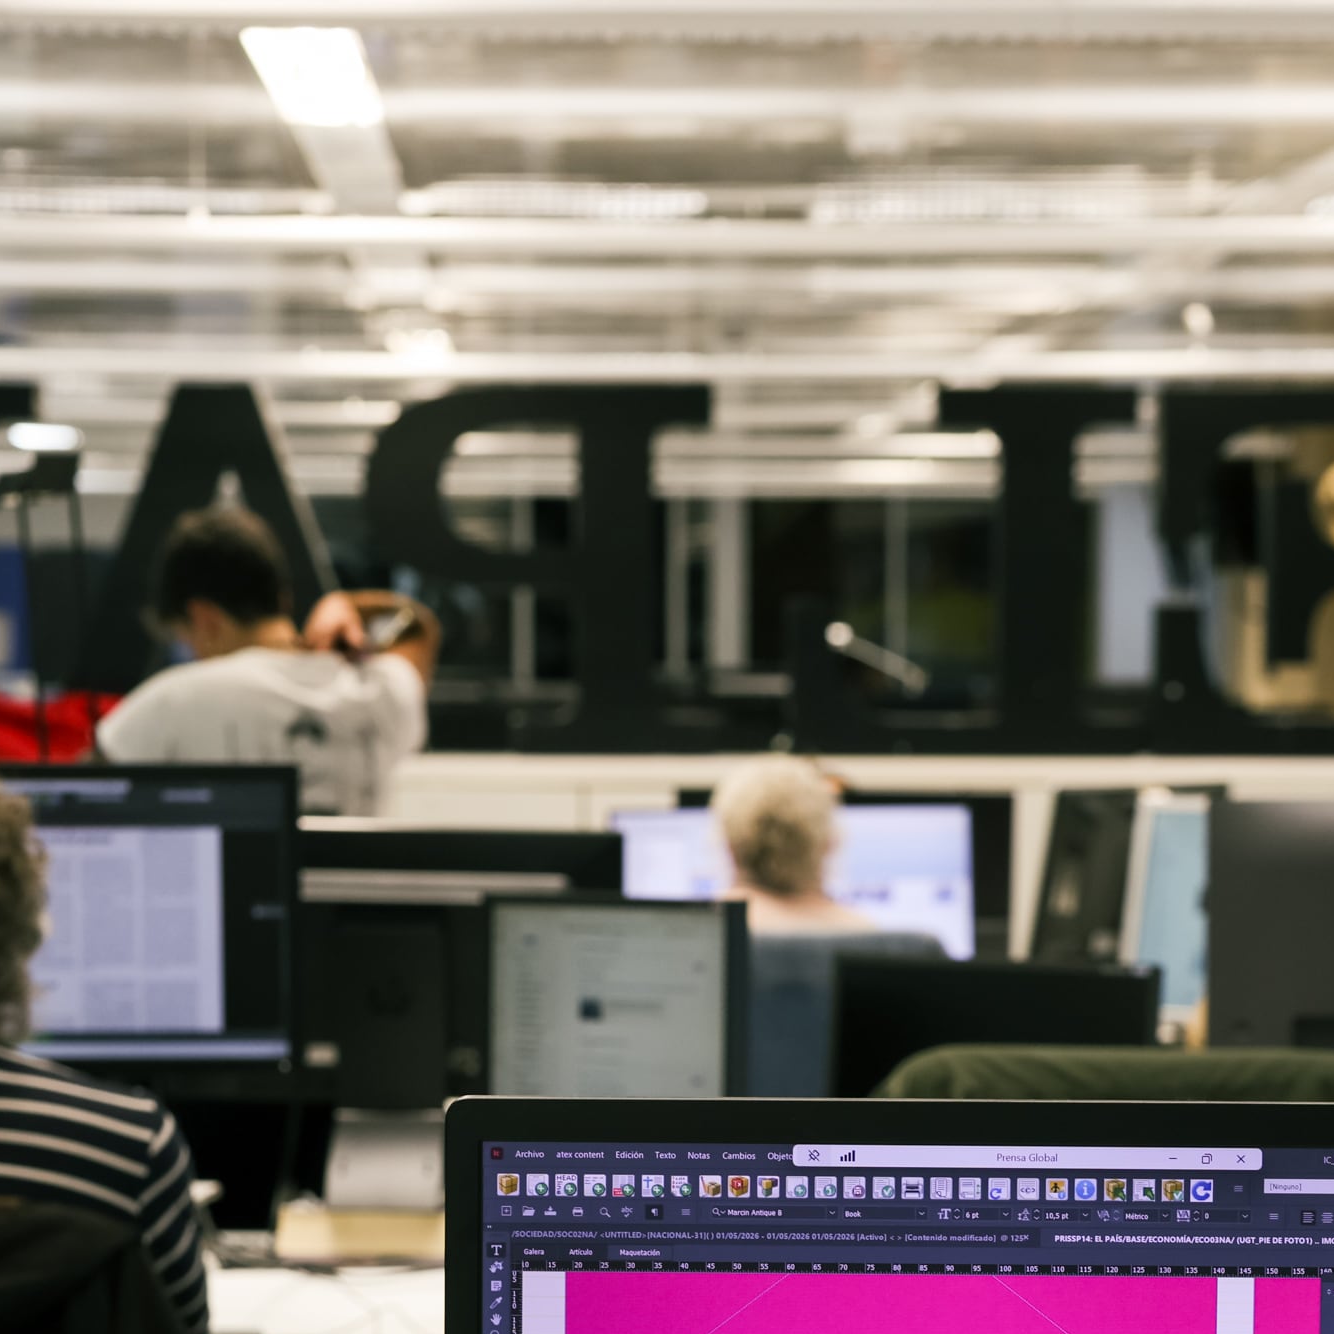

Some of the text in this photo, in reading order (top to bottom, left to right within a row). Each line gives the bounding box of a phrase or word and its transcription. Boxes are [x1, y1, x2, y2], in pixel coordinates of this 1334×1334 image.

[515, 1150, 544, 1158] Archivo
[616, 1151, 643, 1159] Edición
[688, 1152, 709, 1160] Notas
[723, 1152, 755, 1160] Cambios
[997, 1153, 1058, 1162] Prensa Global
[1270, 1183, 1302, 1191] [Ninguno]
[524, 1248, 660, 1257] Galera Artículo Maquetación
